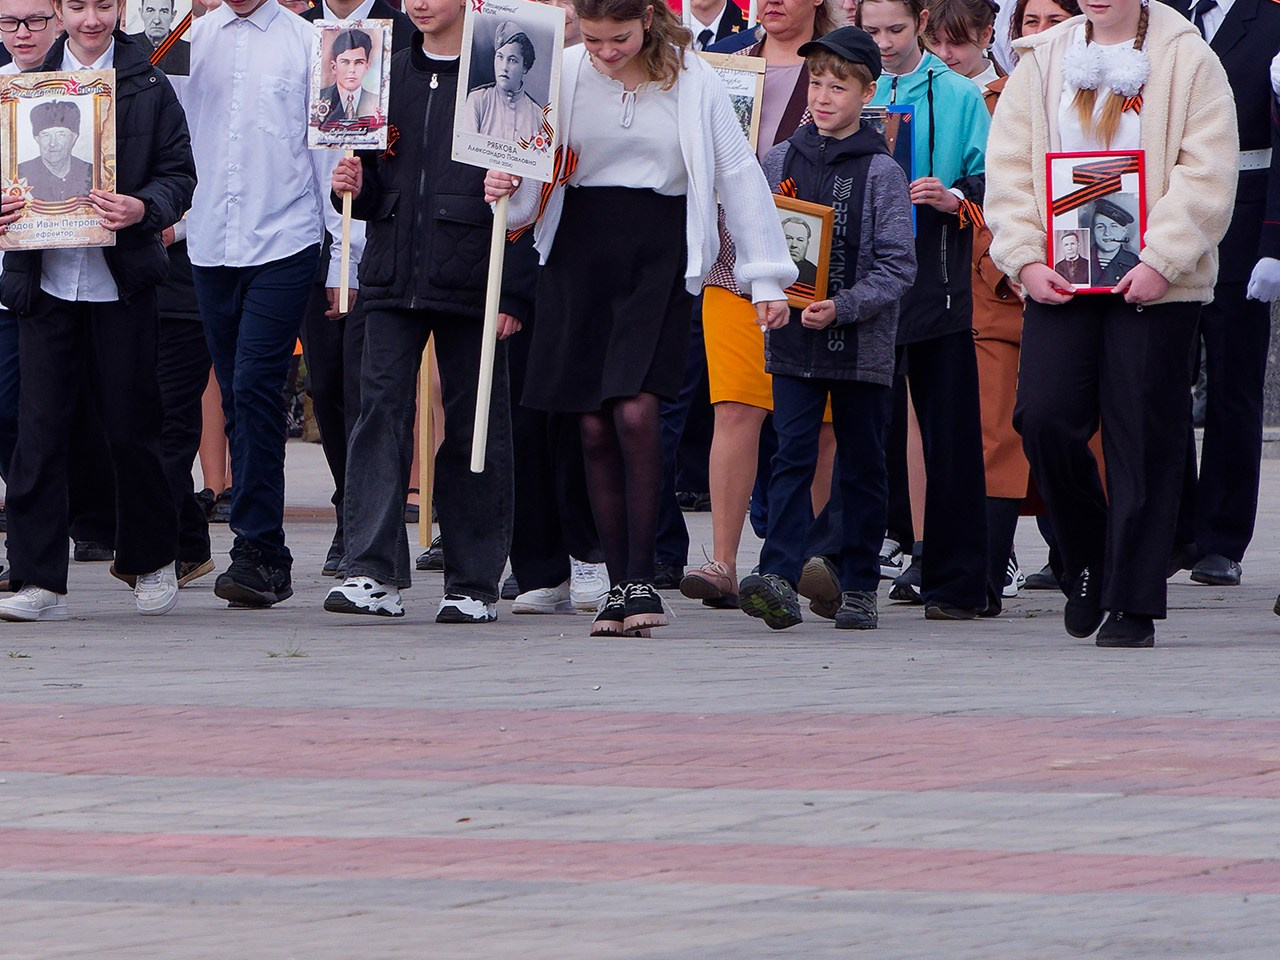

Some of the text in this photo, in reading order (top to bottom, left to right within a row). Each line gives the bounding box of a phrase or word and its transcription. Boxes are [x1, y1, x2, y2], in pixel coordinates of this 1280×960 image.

[486, 141, 518, 154] РЯБКОВА
[506, 153, 537, 166] Павловна
[36, 220, 59, 228] Иван
[61, 219, 108, 228] Петрови
